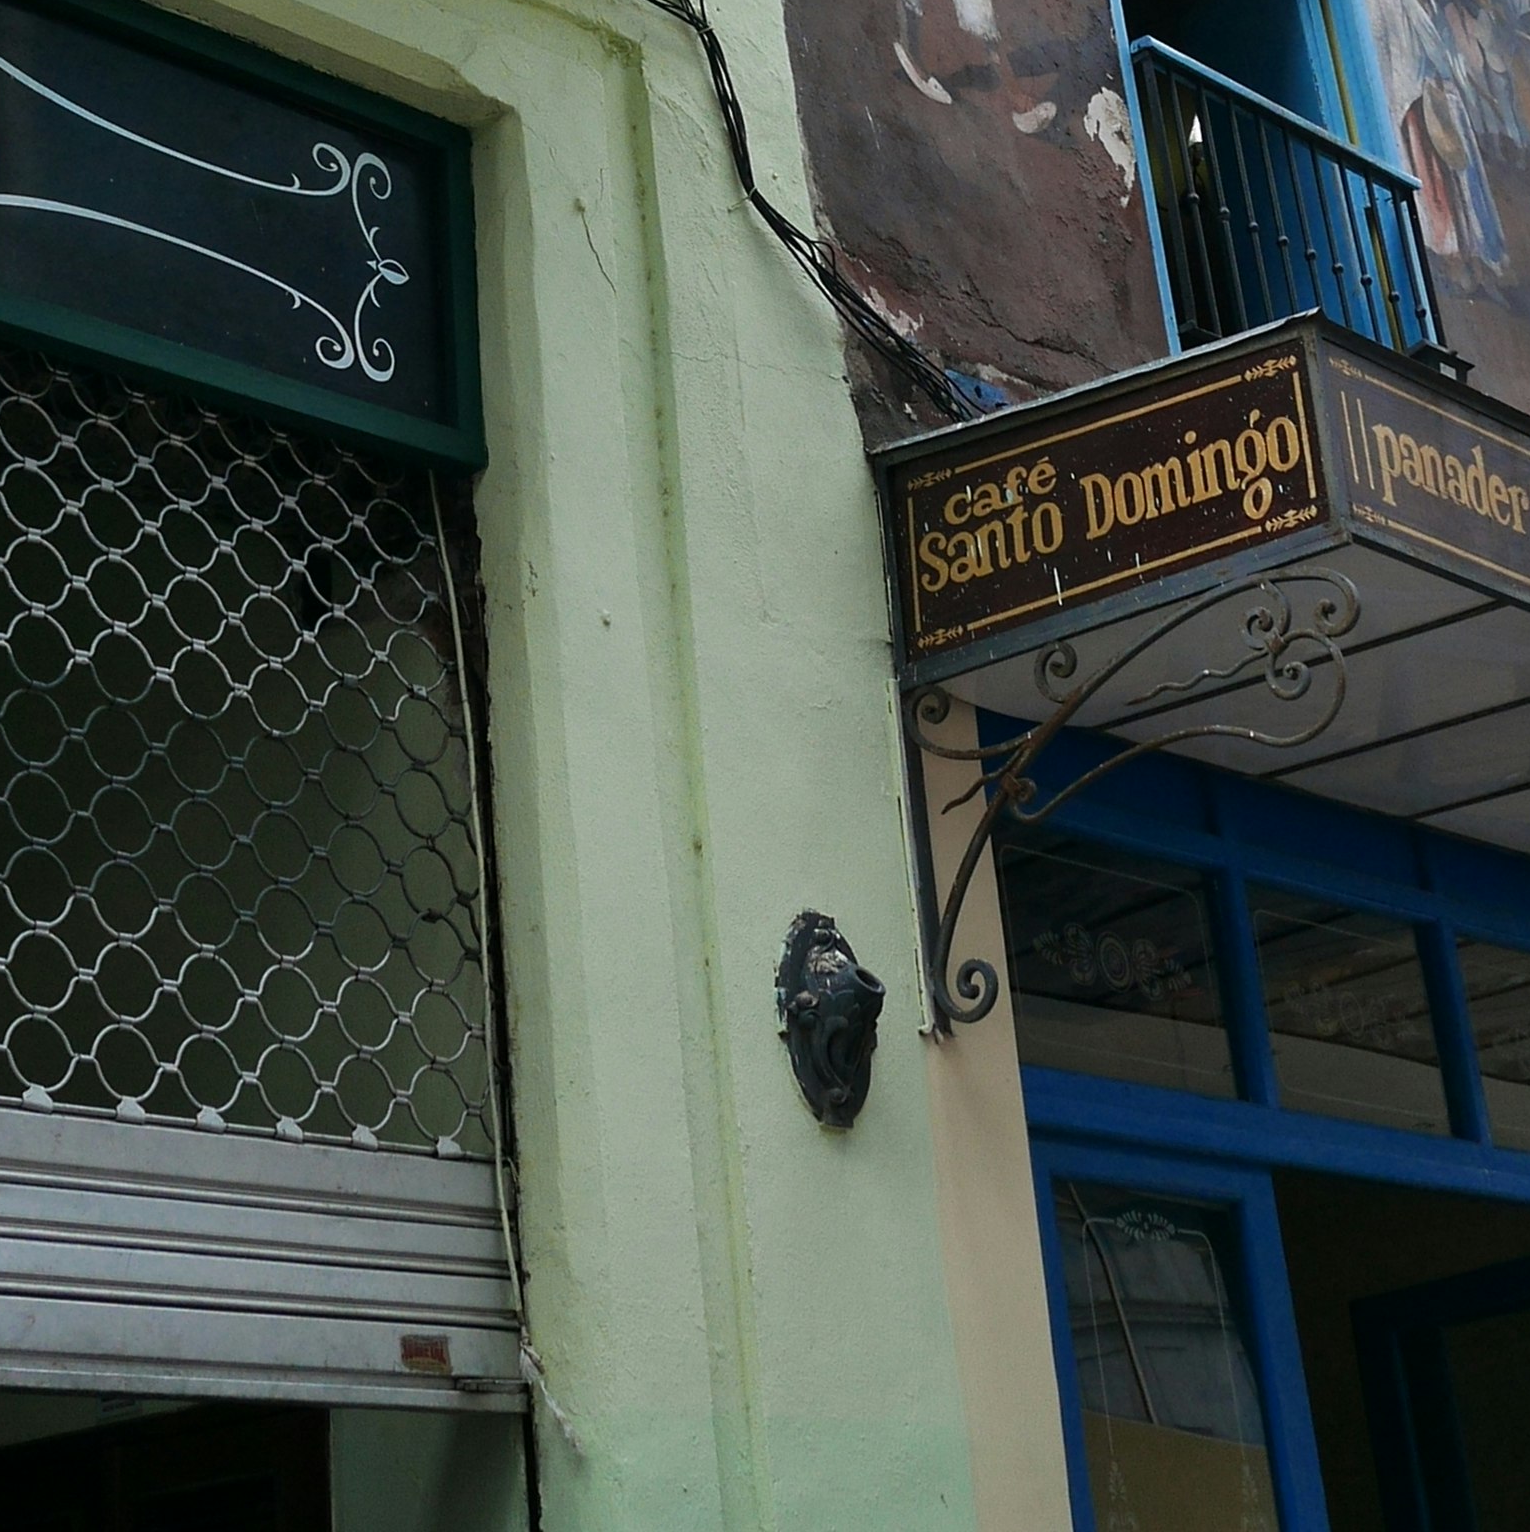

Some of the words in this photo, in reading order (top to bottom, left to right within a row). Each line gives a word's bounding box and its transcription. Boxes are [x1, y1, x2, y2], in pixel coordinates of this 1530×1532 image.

[919, 502, 1064, 593] Santo
[1080, 409, 1300, 540] Domingo
[944, 456, 1058, 526] café
